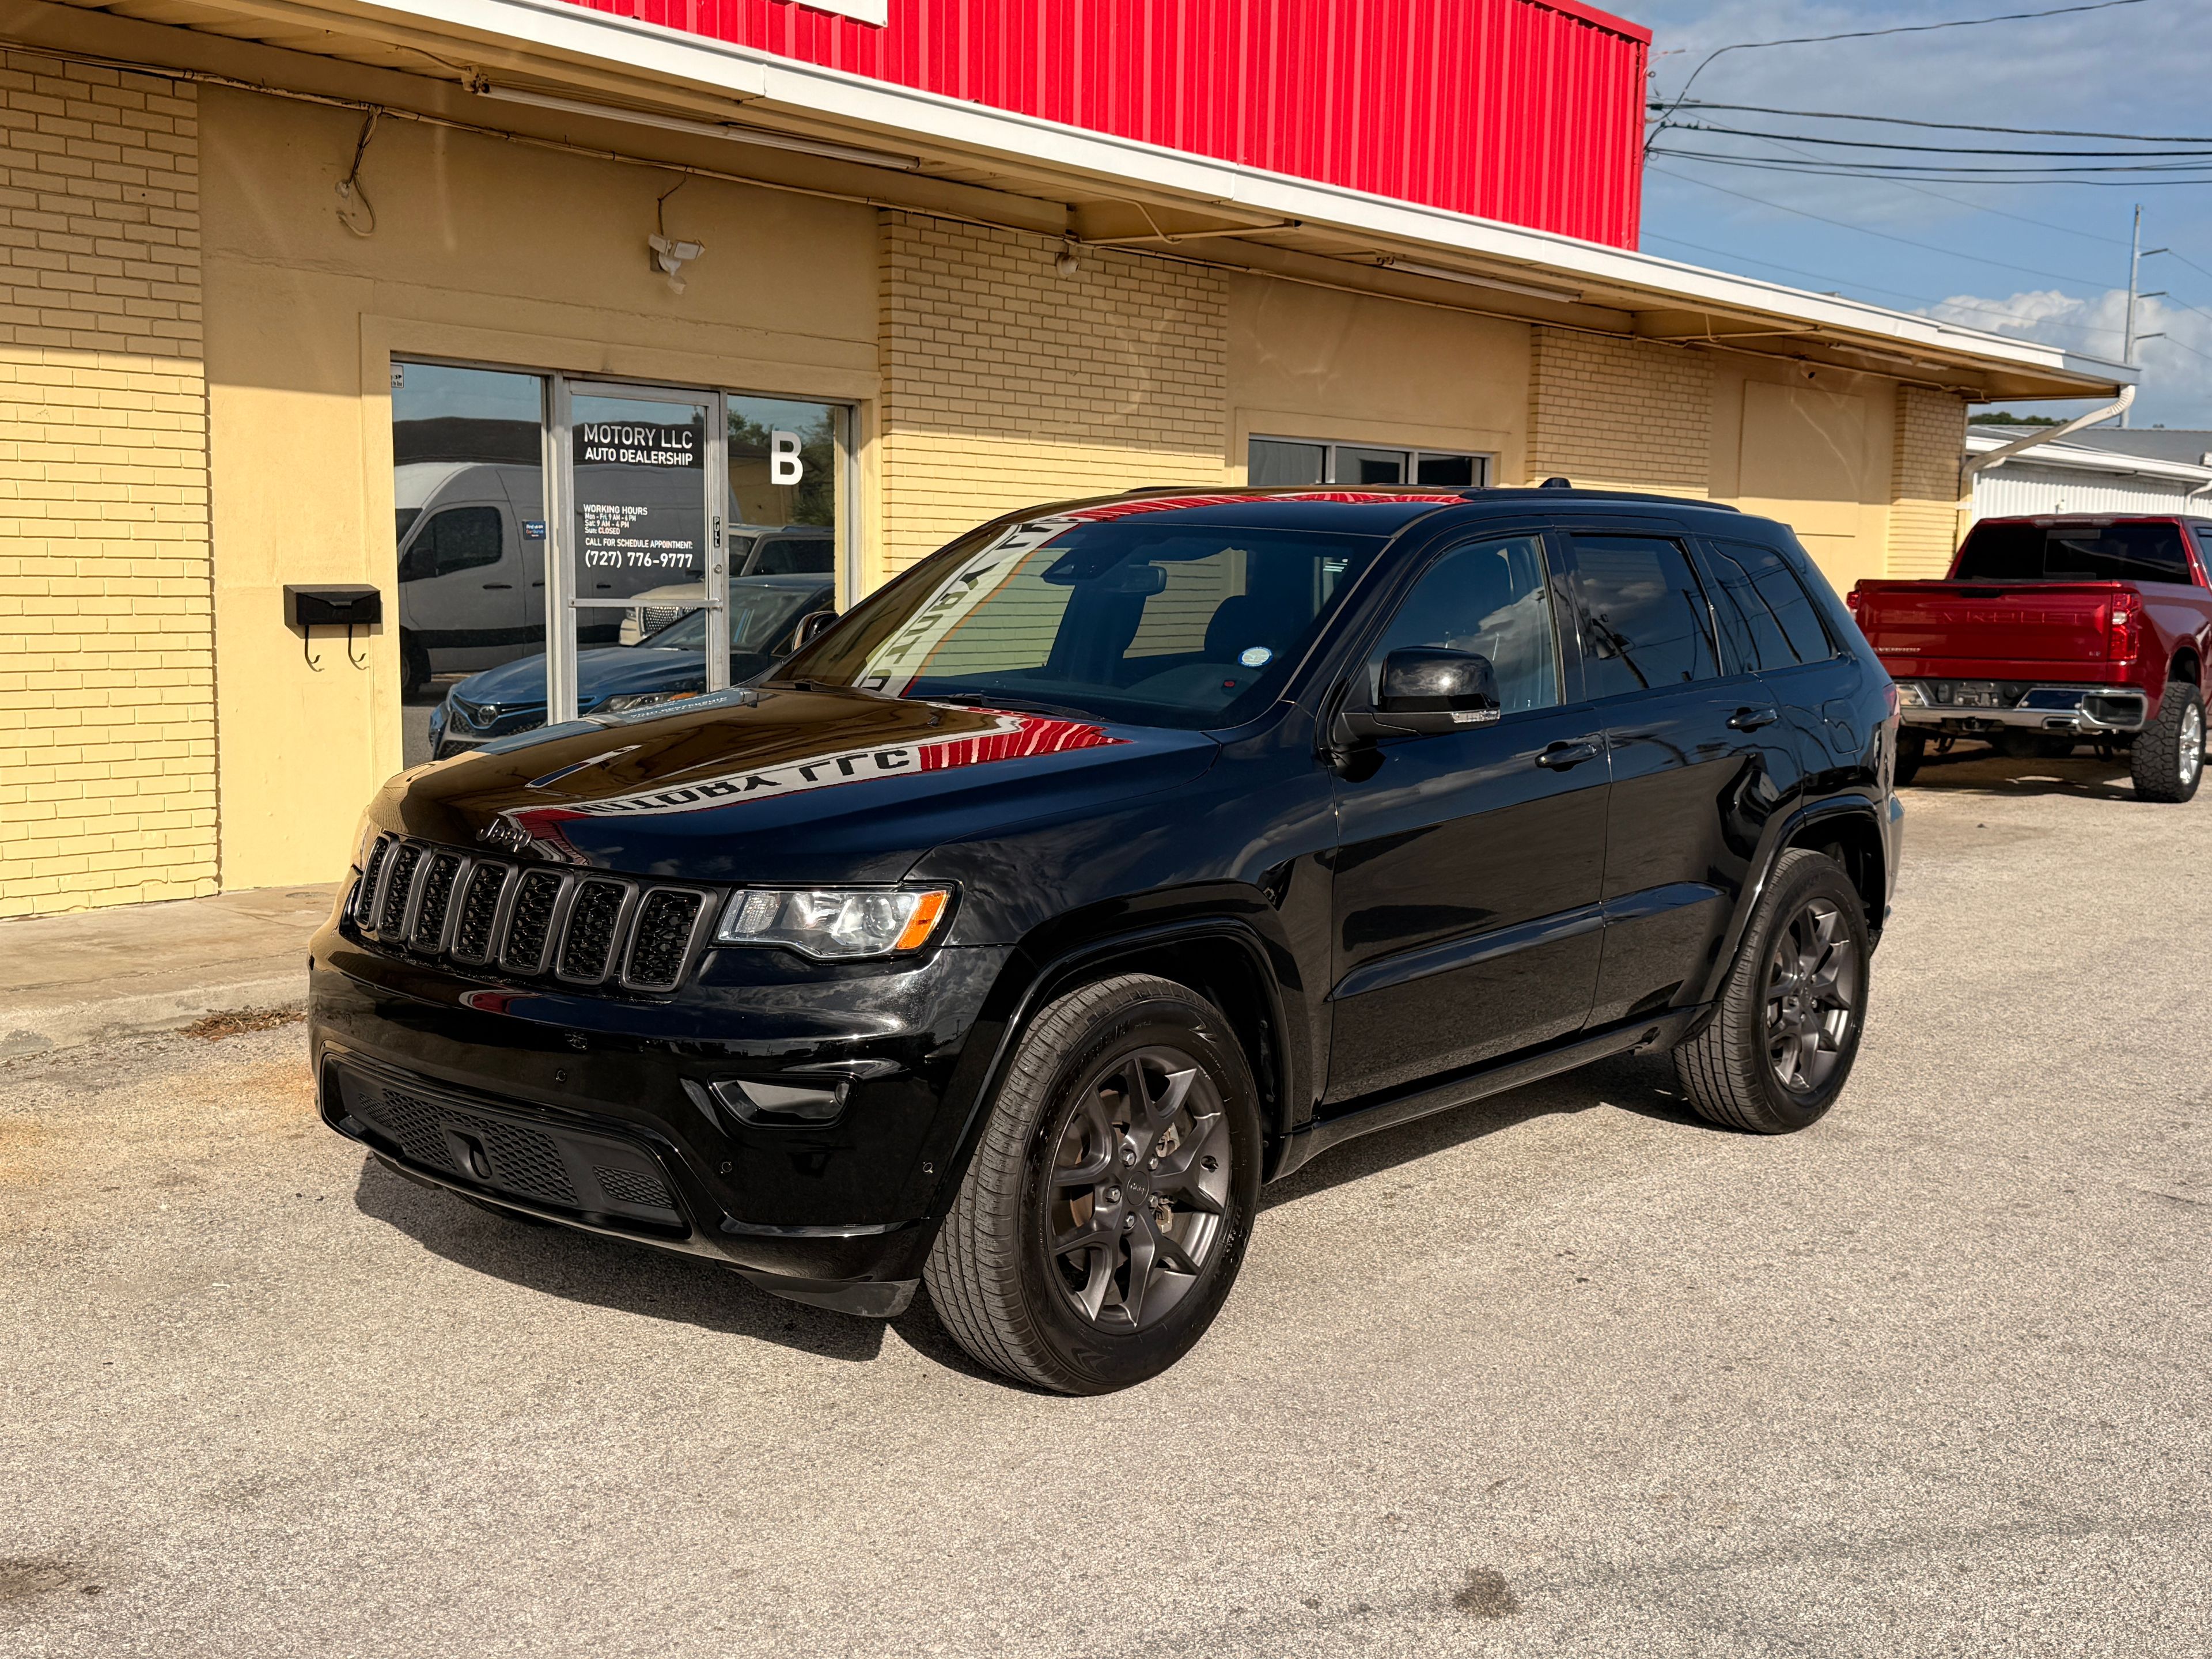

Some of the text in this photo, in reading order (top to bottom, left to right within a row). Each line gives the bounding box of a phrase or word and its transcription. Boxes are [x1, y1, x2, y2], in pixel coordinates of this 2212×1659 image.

[584, 423, 692, 449] MOTORY LLC
[585, 447, 693, 465] AUTO DEALERSHIP
[771, 430, 803, 485] B
[583, 504, 648, 515] WORKING HOURS
[585, 537, 693, 549] CALL FOR SCHEDULE APPOINTMENT:
[585, 550, 693, 568] (727) 776-9777
[476, 819, 532, 853] Jeep
